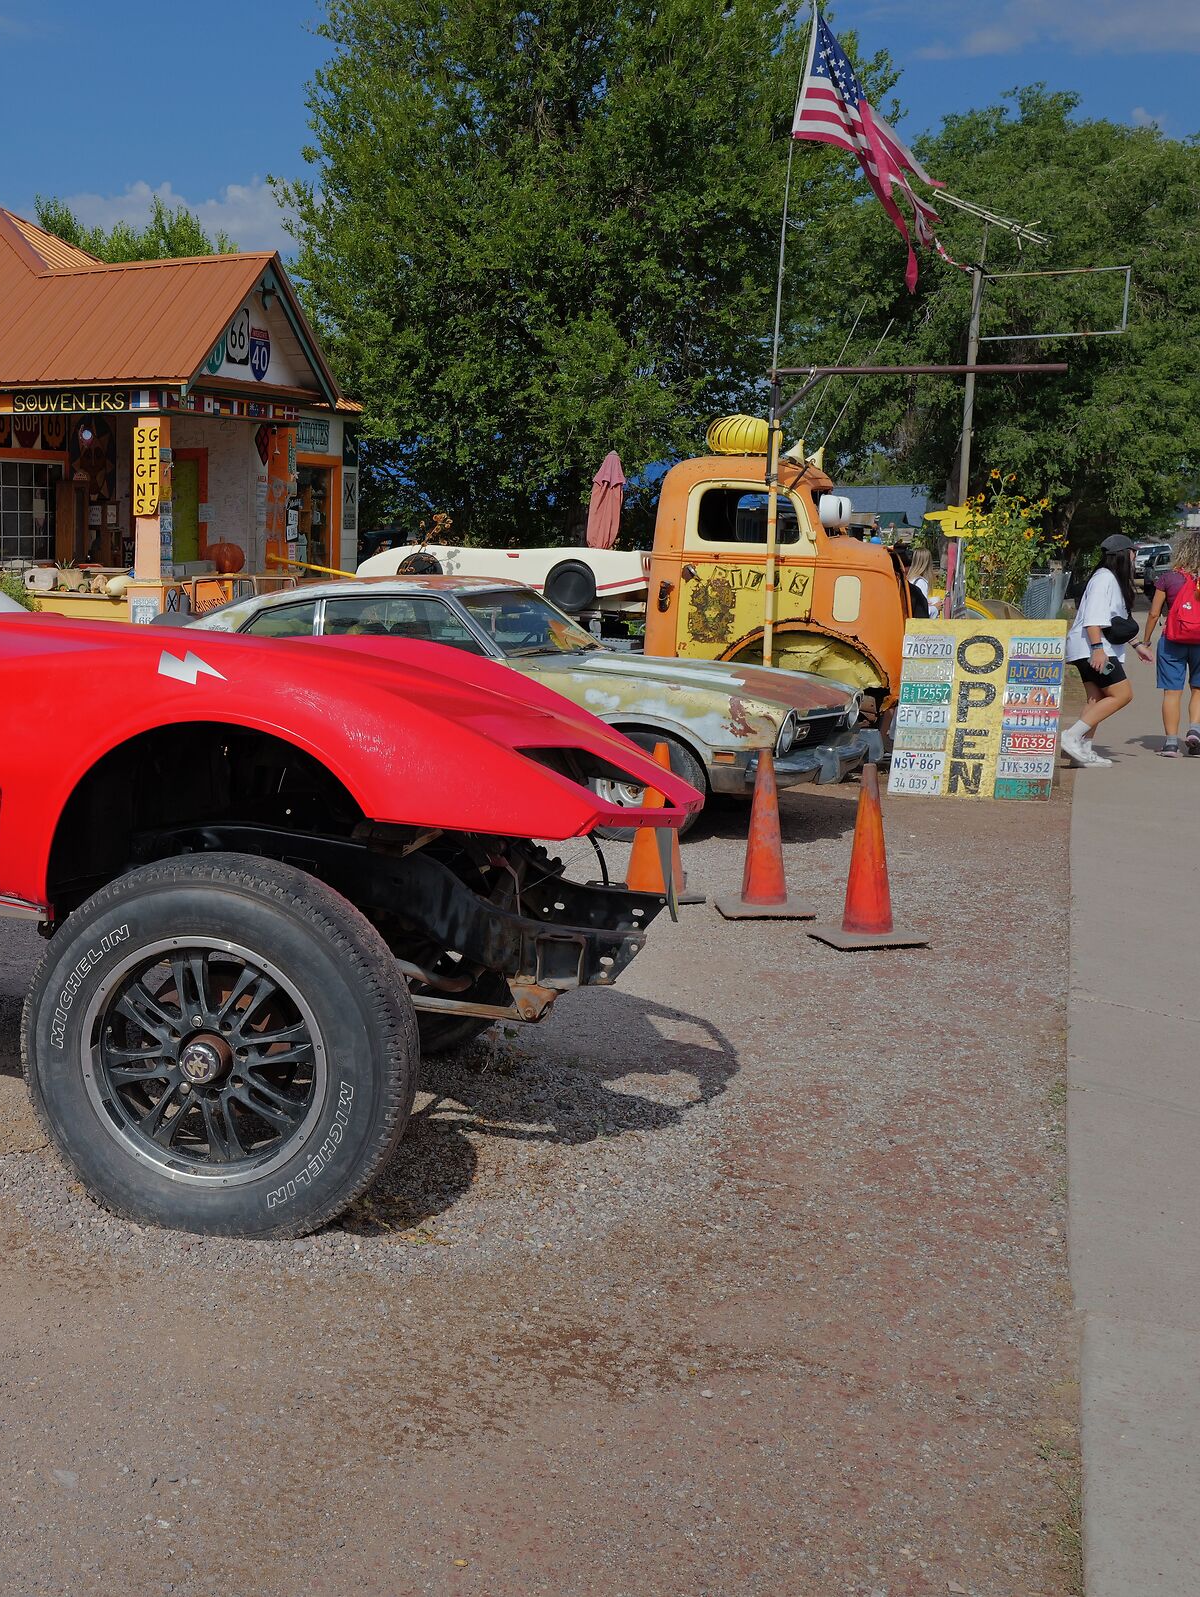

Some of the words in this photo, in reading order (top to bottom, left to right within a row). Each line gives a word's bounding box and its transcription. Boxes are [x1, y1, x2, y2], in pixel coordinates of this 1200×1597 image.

[230, 320, 246, 350] 66
[251, 345, 268, 372] 40
[13, 392, 126, 412] SOUVENIRS
[14, 414, 39, 432] STOP
[135, 428, 147, 514] SIGNS
[148, 428, 159, 514] GIFTS
[954, 519, 987, 530] LOO
[906, 643, 953, 656] 7AGY270
[1016, 642, 1062, 655] BGK1916
[917, 686, 950, 700] 12557
[925, 710, 946, 723] 621
[947, 635, 1005, 795] OPEN
[1005, 737, 1054, 749] BYR396
[893, 777, 905, 788] 34
[908, 778, 928, 790] 039
[50, 924, 130, 1049] MICHELIN
[266, 1081, 354, 1209] MICHELIN
